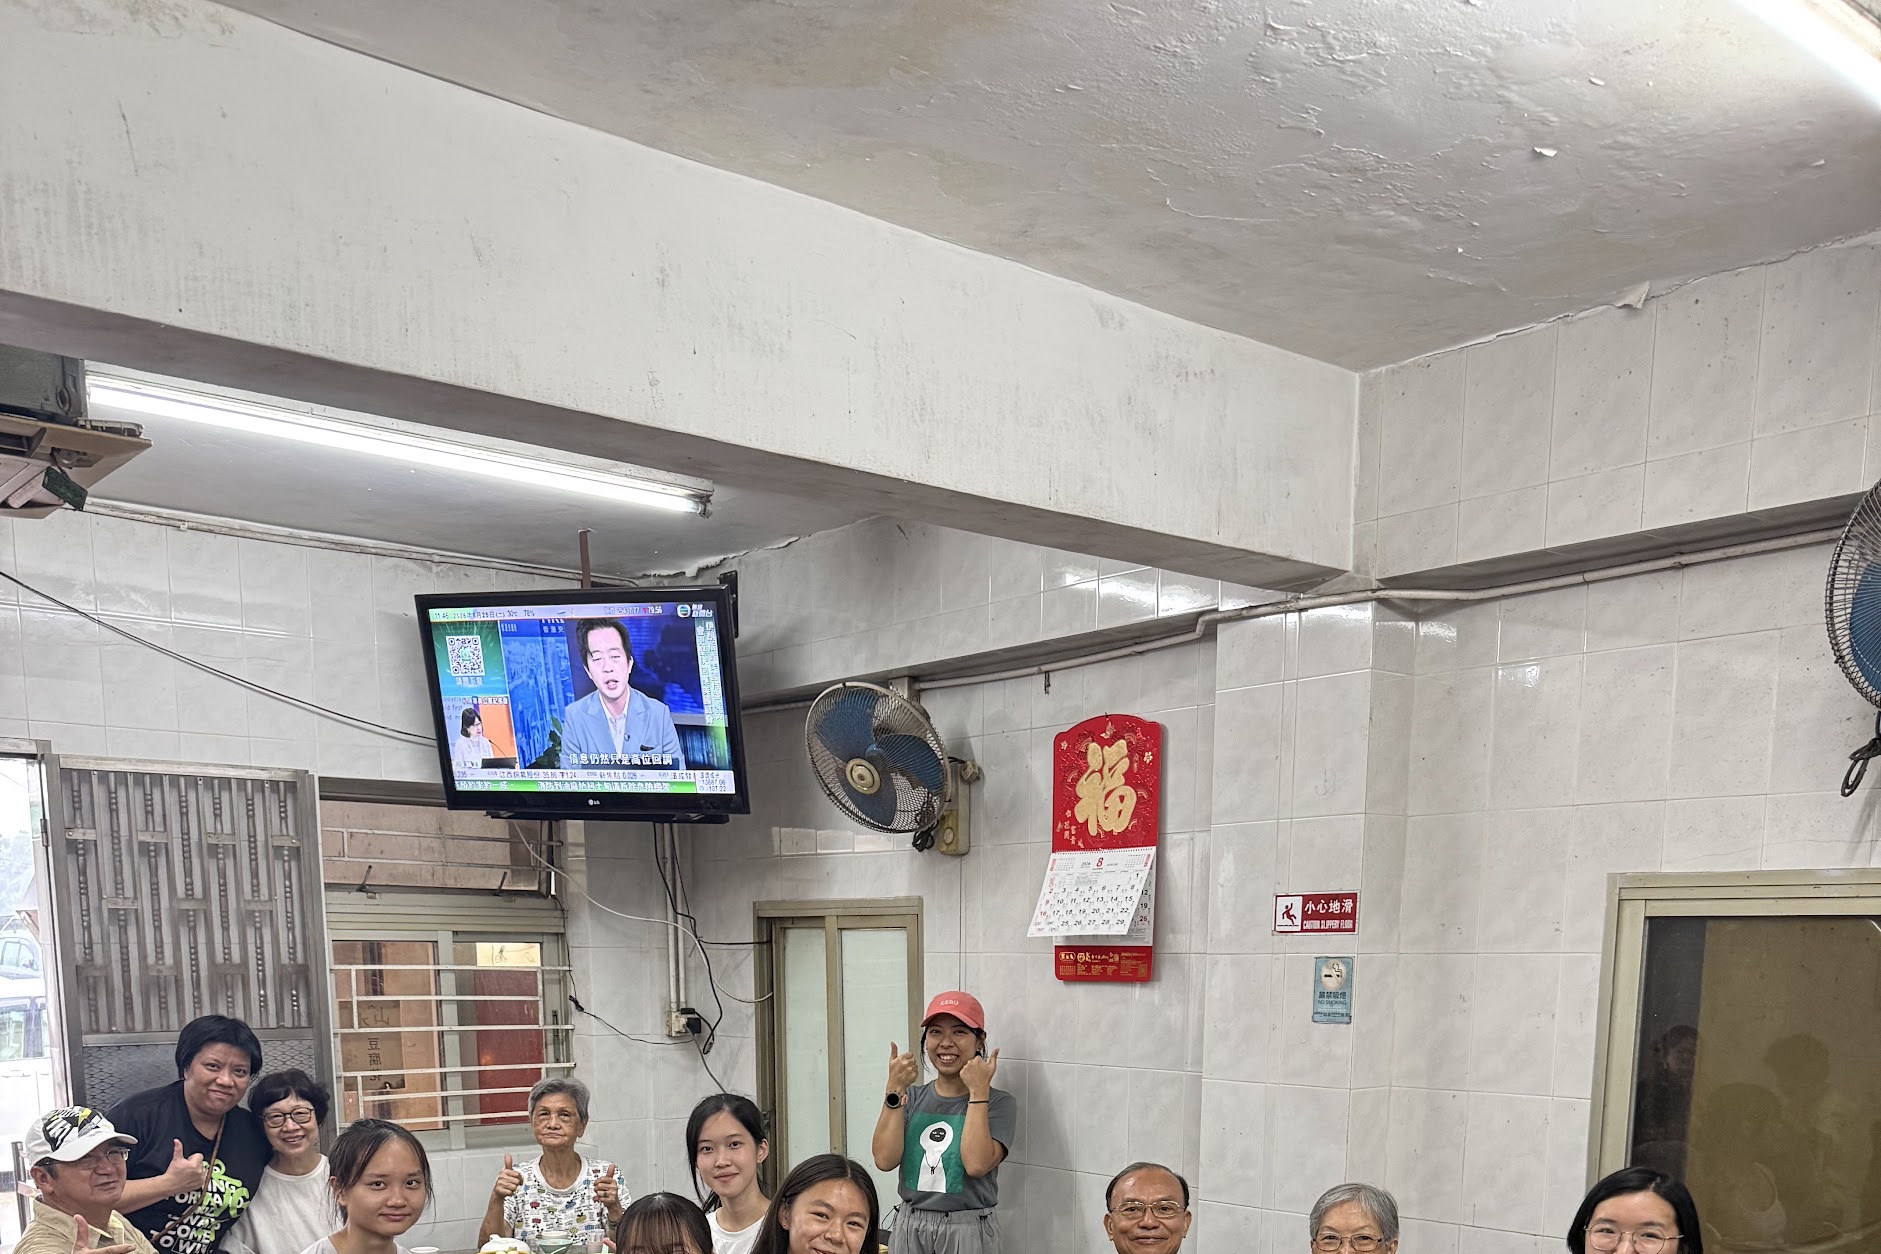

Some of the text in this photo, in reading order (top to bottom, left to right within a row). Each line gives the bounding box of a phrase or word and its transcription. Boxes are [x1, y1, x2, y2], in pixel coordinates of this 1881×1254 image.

[1074, 739, 1138, 836] 福
[1096, 857, 1104, 868] 8
[1304, 899, 1353, 914] 小心地滑
[1321, 920, 1340, 929] SLIPPERY
